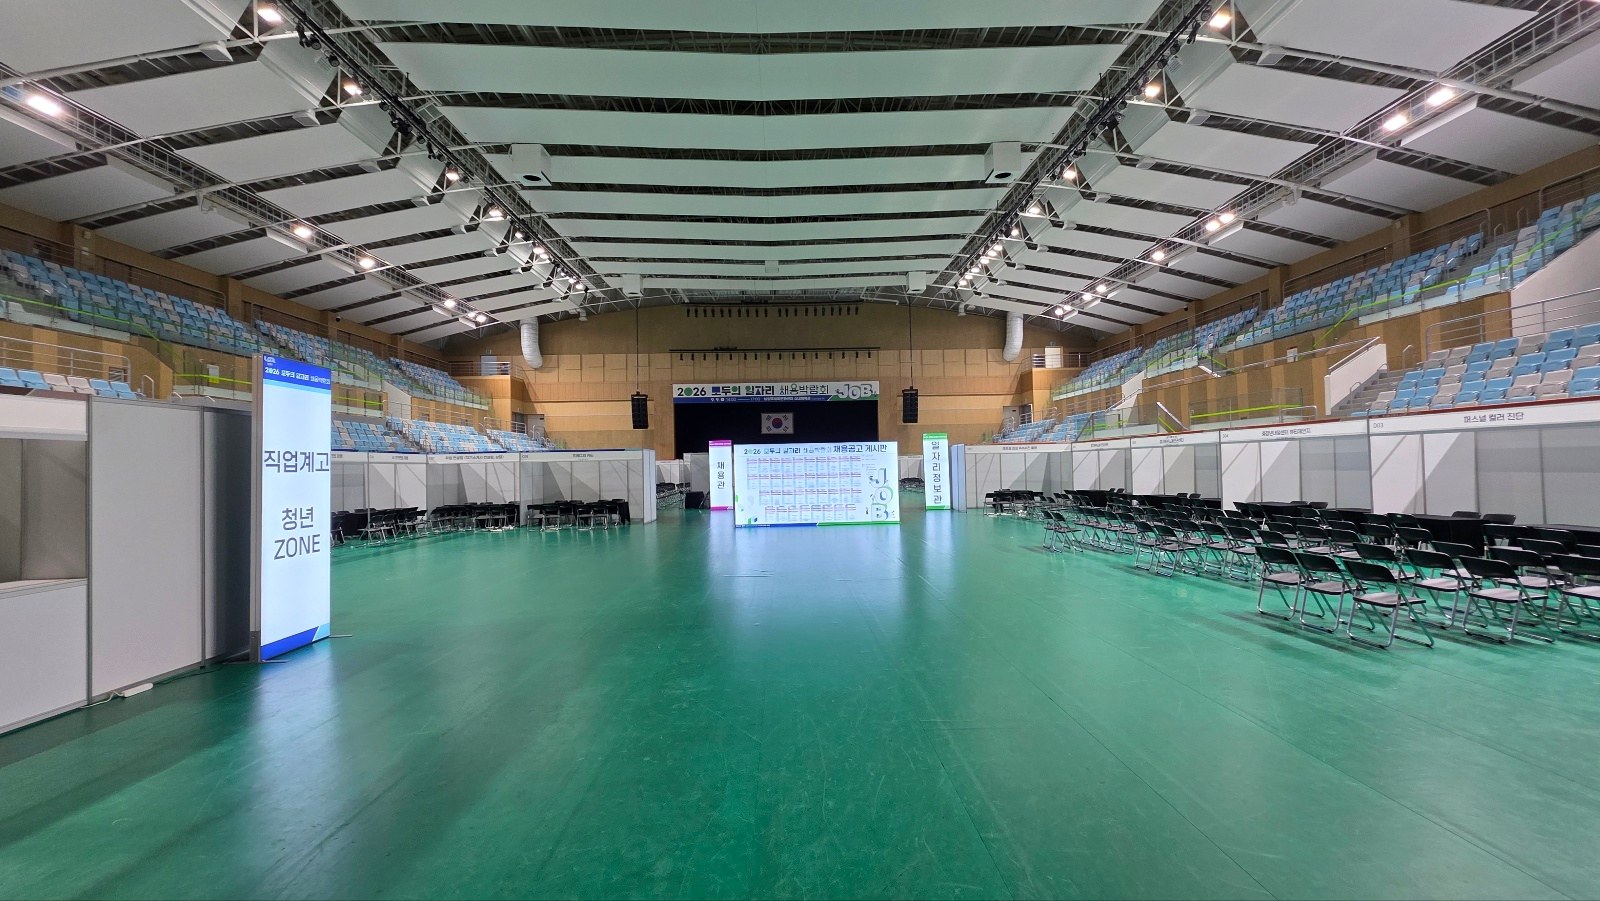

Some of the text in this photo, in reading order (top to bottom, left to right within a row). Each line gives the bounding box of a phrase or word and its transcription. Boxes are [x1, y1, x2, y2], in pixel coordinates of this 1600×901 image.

[264, 367, 280, 375] 2026
[677, 383, 829, 396] 2026 모두의 일자리 채용박람회
[838, 383, 873, 399] JOB
[1463, 412, 1524, 423] 퍼스널 컬러 진단
[833, 444, 863, 453] 채용공고
[865, 444, 888, 453] 게시판
[263, 450, 330, 473] 직업계고
[716, 461, 725, 489] 채용관
[931, 441, 943, 504] 일자리정보관
[281, 506, 314, 531] 청년
[273, 534, 321, 561] ZONE
